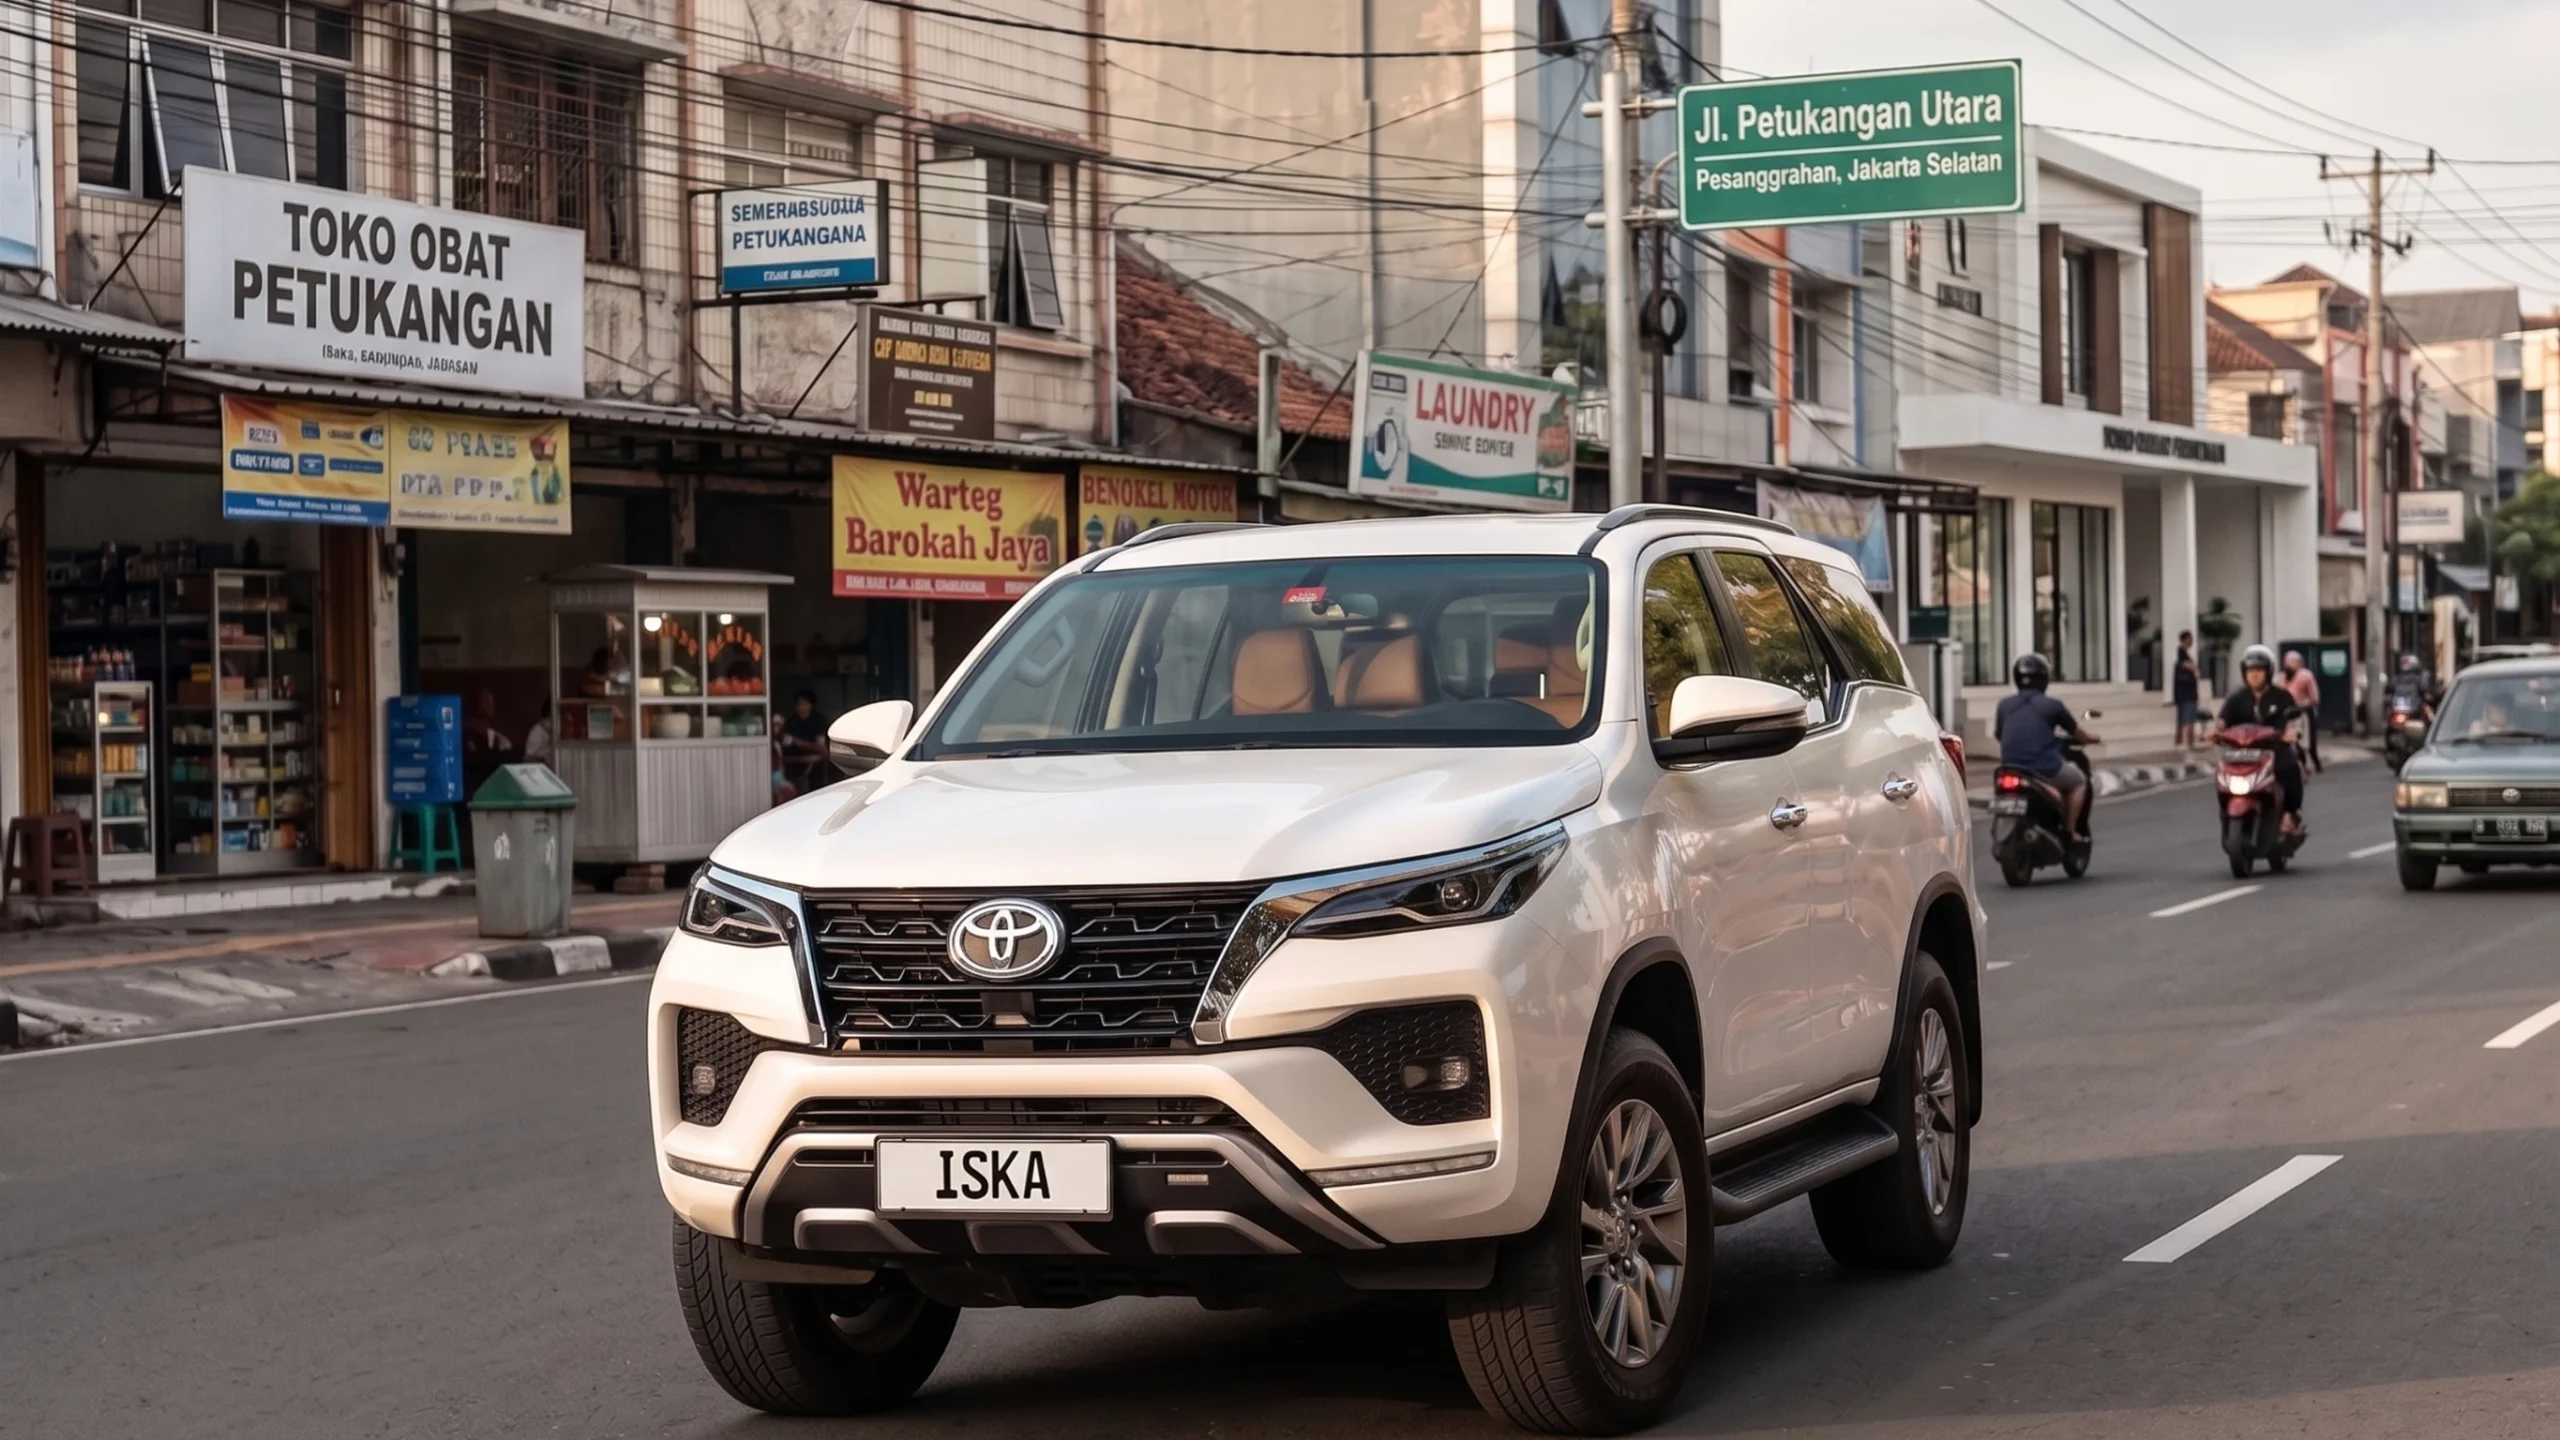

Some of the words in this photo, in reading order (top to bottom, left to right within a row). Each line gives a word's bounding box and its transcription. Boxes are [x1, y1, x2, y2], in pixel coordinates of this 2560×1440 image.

[1694, 107, 1729, 144] Jl.
[1737, 99, 1912, 141] Petukangan
[1920, 89, 2003, 127] Utara
[1696, 162, 1843, 194] Pesanggrahan,
[1847, 155, 1921, 182] Jakarta
[1926, 151, 2003, 176] Selatan
[282, 201, 397, 265] TOKO
[409, 222, 511, 281] OBAT
[732, 224, 867, 250] PETUKANGANA
[233, 258, 553, 357] PETUKANGAN
[1415, 379, 1537, 435] LAUNDRY
[894, 470, 1004, 522] Warteg
[1172, 481, 1234, 513] MOTOR
[845, 516, 977, 560] Barokah
[984, 525, 1050, 572] Jaya
[935, 1149, 1051, 1200] ISKA
